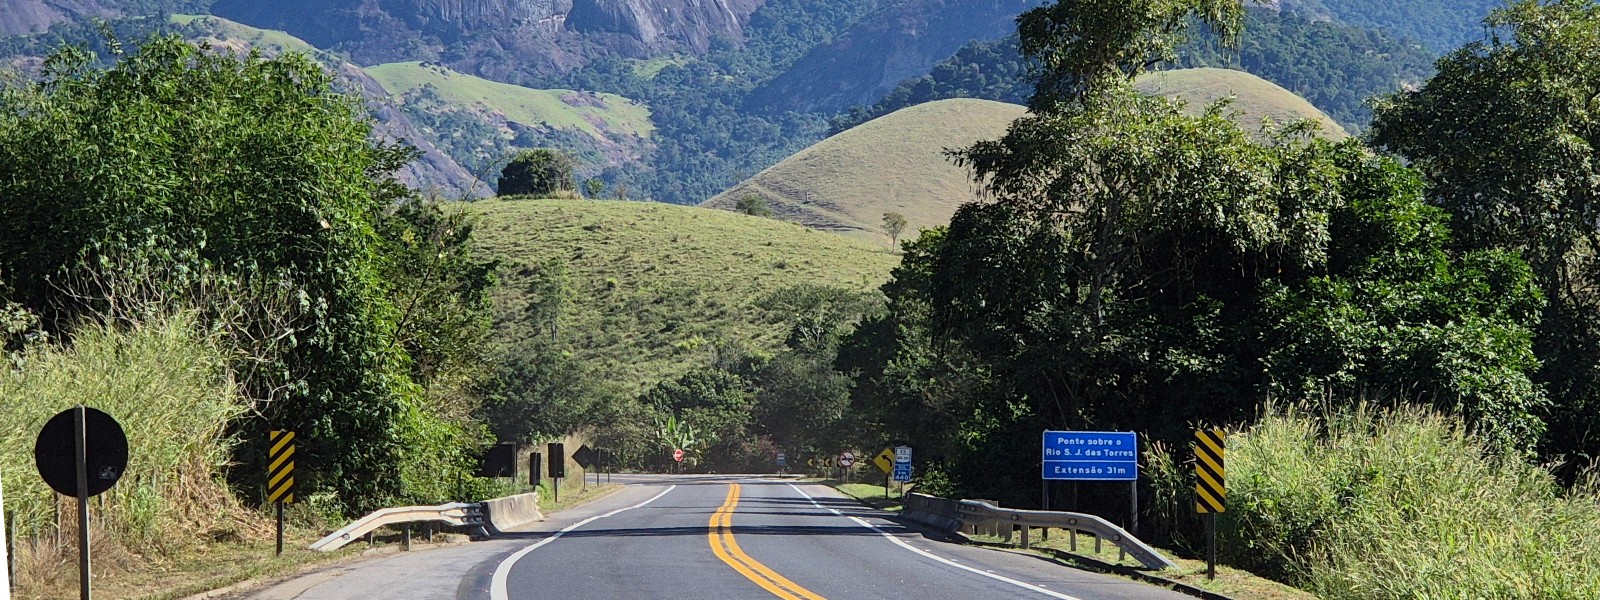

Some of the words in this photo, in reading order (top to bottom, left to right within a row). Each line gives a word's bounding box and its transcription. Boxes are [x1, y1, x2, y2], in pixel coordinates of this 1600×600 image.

[1057, 437, 1085, 445] Ponte
[1087, 438, 1113, 446] sobre
[1046, 448, 1061, 456] Rio
[1064, 448, 1072, 456] S.
[1075, 448, 1082, 456] J.
[1104, 449, 1134, 457] Torres
[1054, 466, 1103, 474] Extensão
[1107, 466, 1126, 474] 31m
